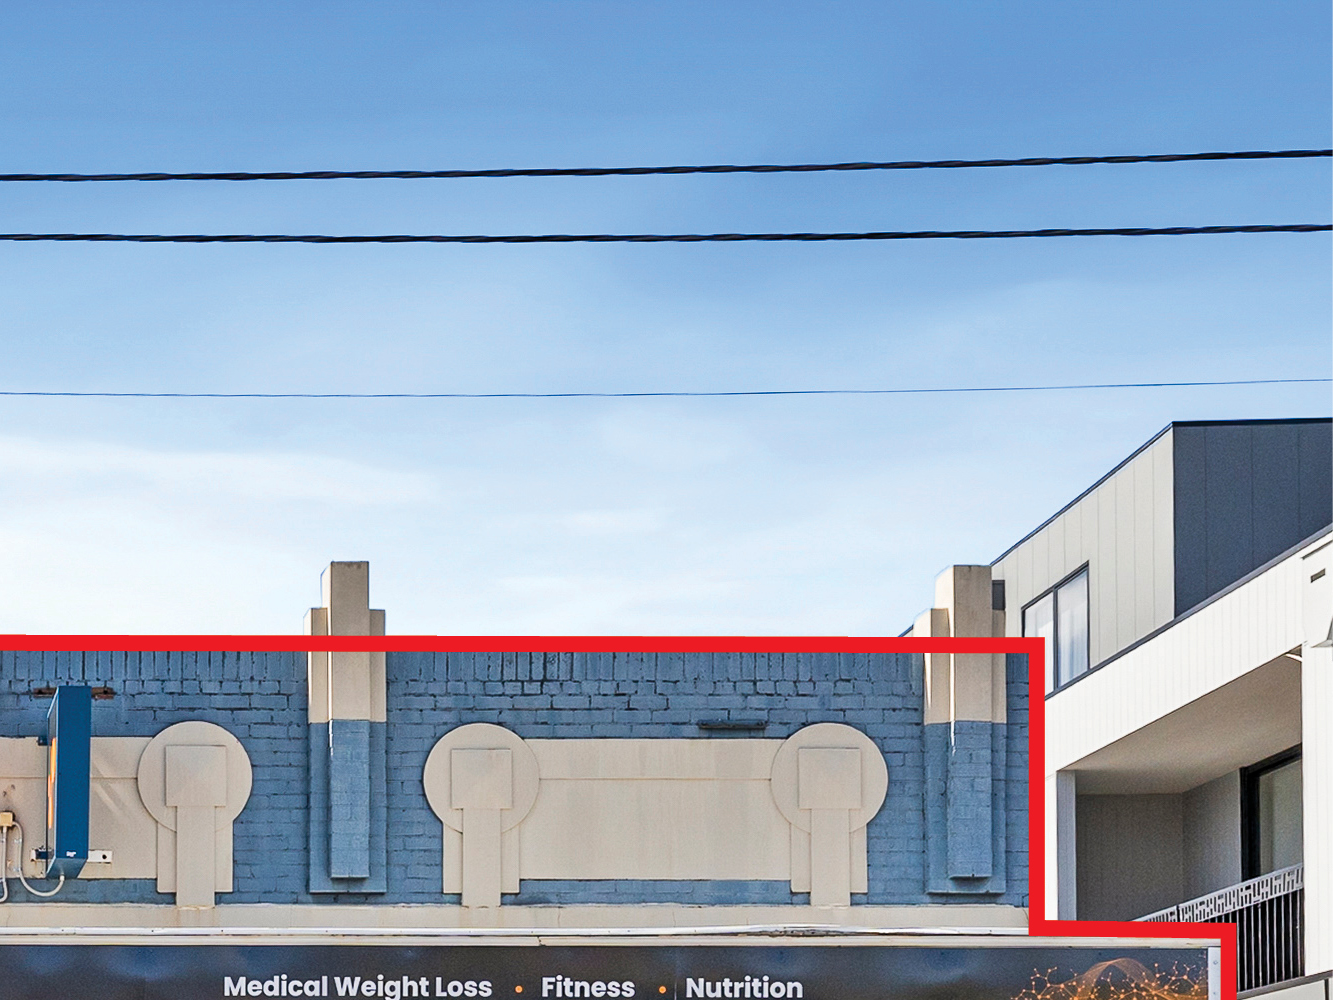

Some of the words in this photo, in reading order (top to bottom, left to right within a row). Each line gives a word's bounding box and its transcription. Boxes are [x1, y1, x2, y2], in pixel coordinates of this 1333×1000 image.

[223, 974, 328, 997] Medical
[435, 976, 492, 997] Loss
[541, 975, 635, 998] Fitness
[686, 975, 803, 998] Nutrition
